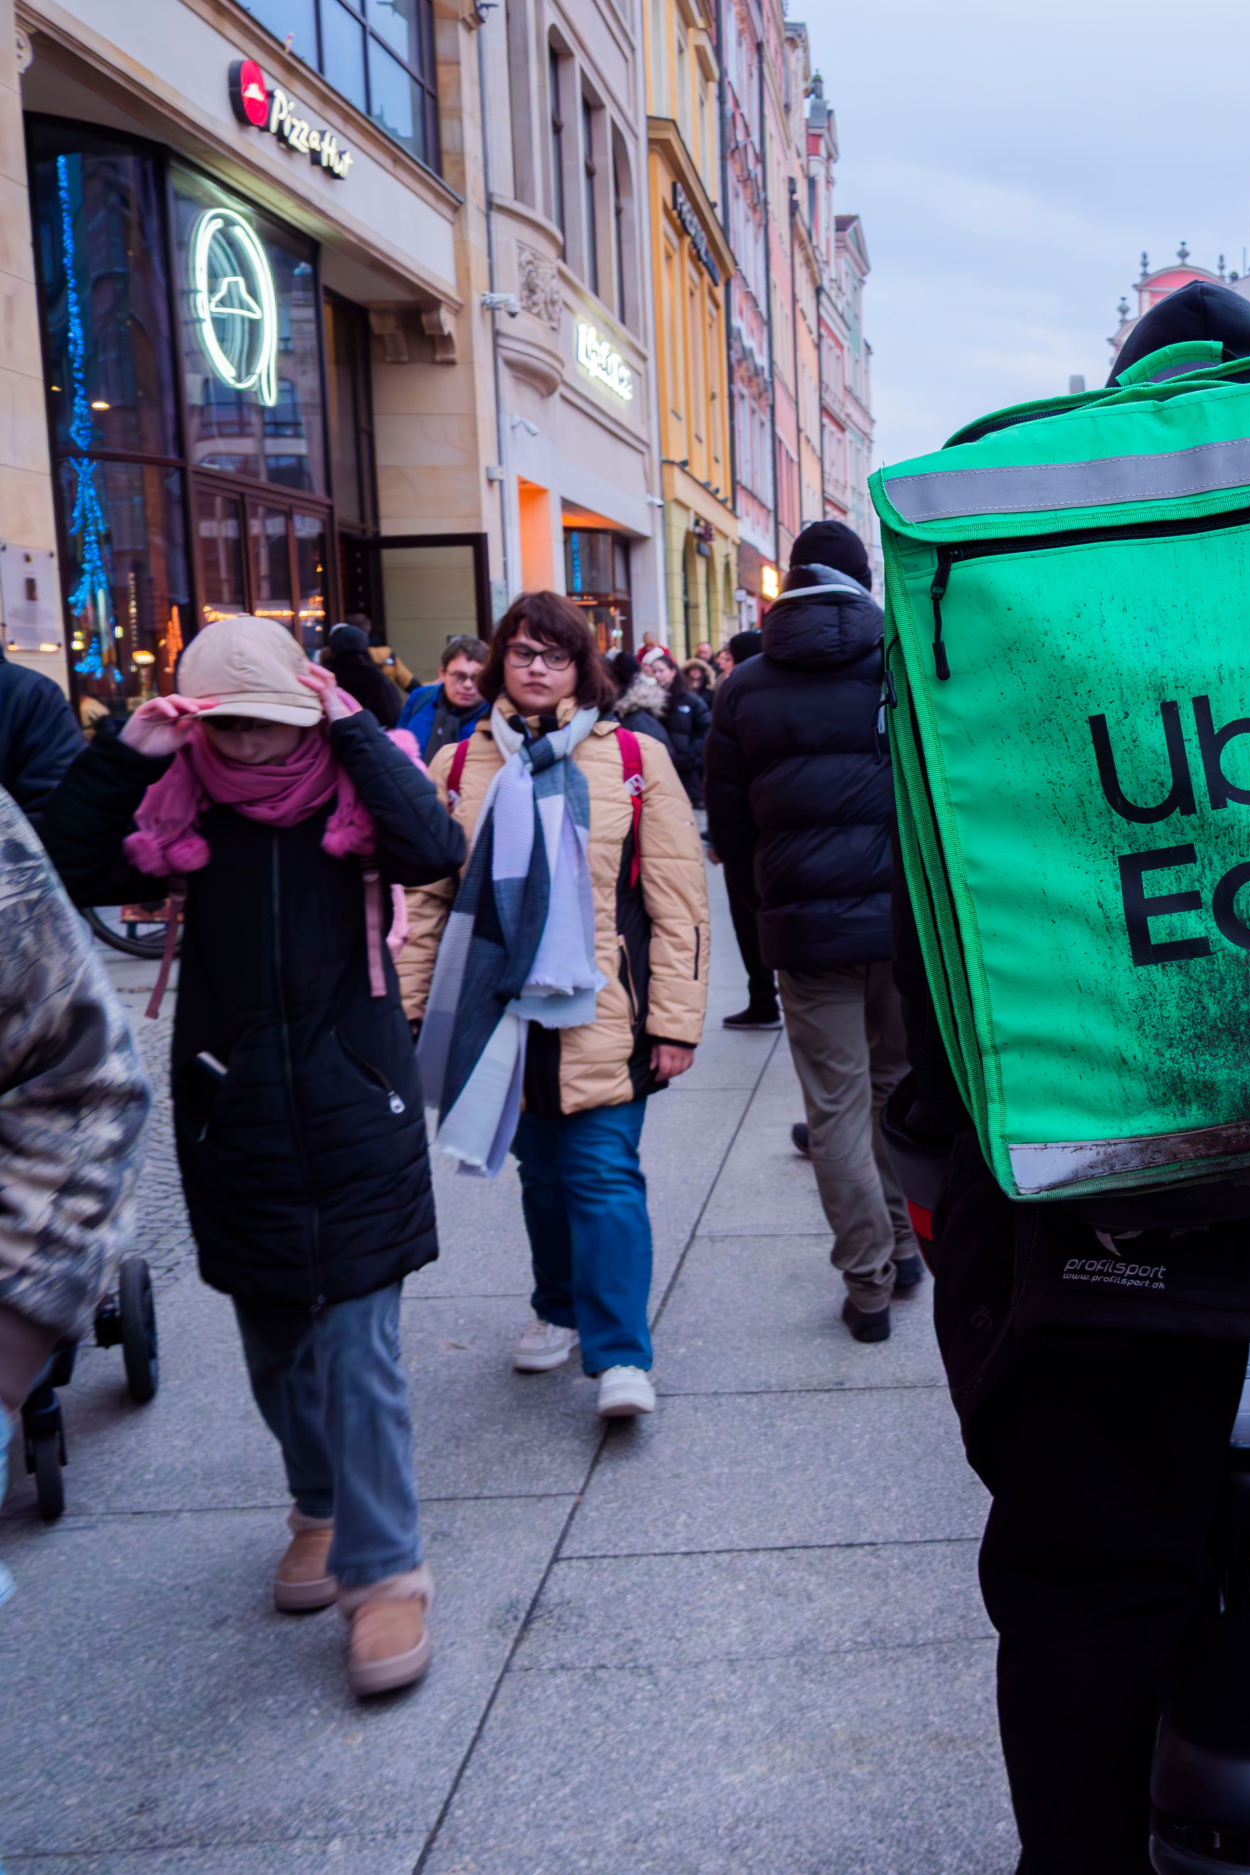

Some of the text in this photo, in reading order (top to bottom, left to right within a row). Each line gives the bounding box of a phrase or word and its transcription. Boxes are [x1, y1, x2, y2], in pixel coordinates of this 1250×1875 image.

[269, 88, 354, 177] Pizza Hut
[1063, 1258, 1167, 1279] profilsport
[1062, 1272, 1166, 1290] www.profilsport.dk
